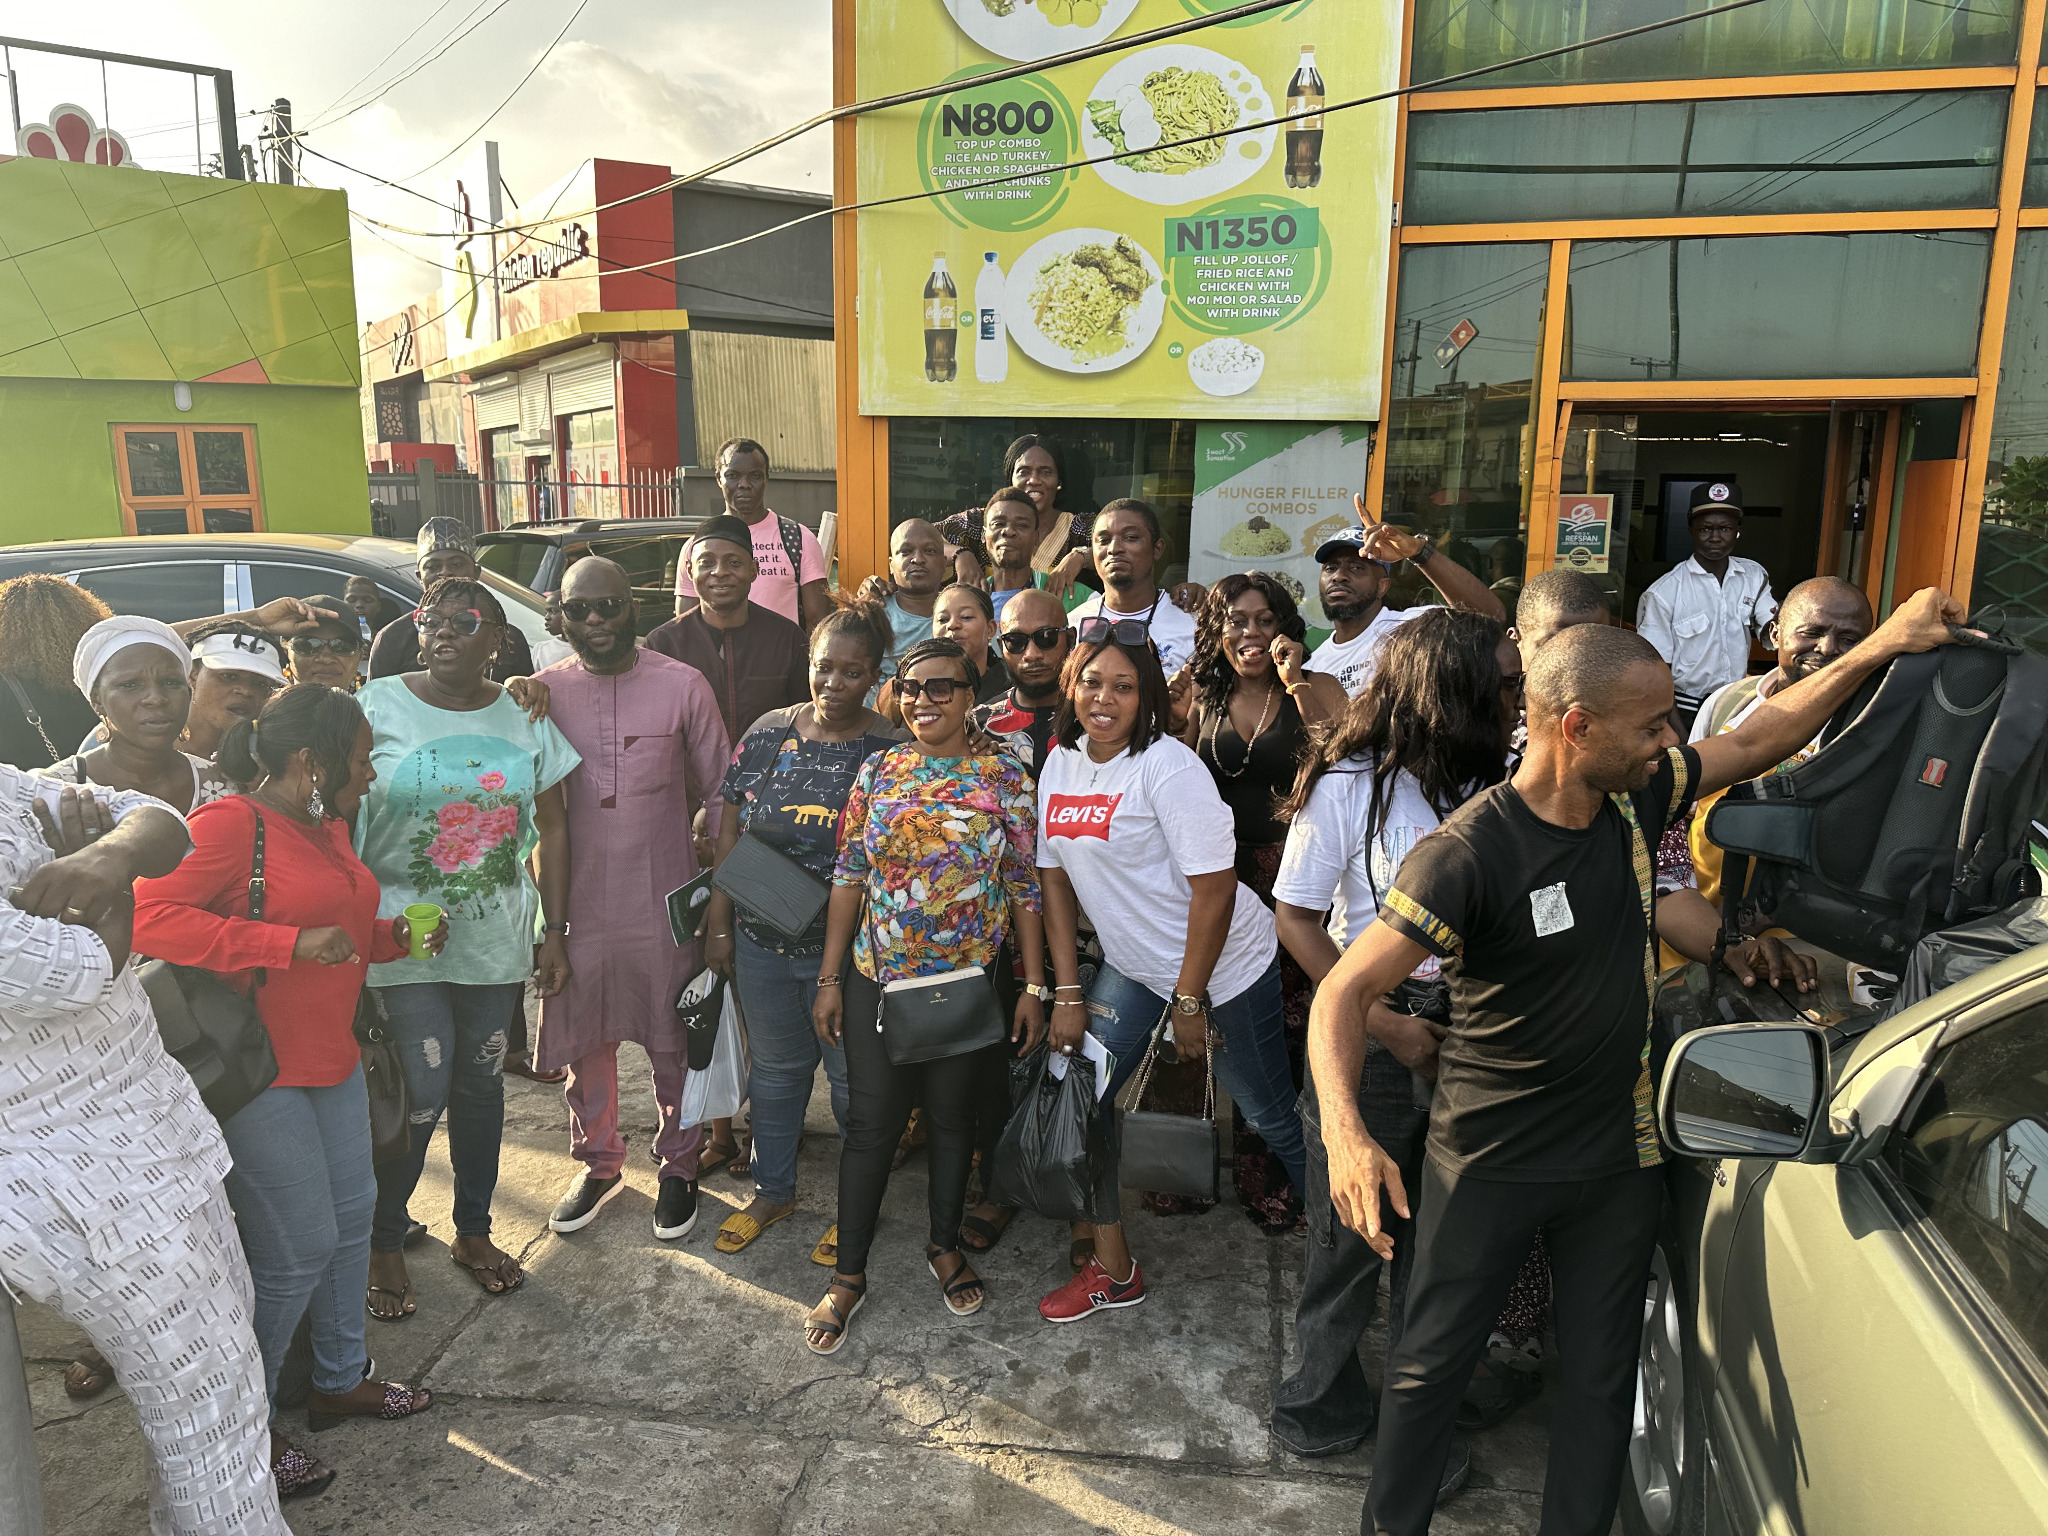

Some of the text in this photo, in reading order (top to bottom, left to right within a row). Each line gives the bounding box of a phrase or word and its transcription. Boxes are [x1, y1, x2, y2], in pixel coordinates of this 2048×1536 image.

[943, 101, 1054, 137] N800
[955, 138, 1041, 149] TOP UP COMBO
[944, 150, 1052, 163] RICE AND TURKEY/
[931, 166, 981, 176] CHICKEN
[983, 165, 1000, 175] OR
[944, 179, 969, 189] AND
[1004, 176, 1051, 187] CHUNKS
[963, 190, 1032, 201] WITH DRINK
[1177, 214, 1297, 252] N1350
[1193, 256, 1219, 266] FILL
[1222, 255, 1239, 265] UP
[1241, 254, 1289, 265] JOLLOF
[1196, 268, 1294, 279] FRIED RICE AND
[1199, 281, 1290, 292] CHICKEN WITH
[1187, 294, 1302, 305] MOI MOI OR SALAD
[1207, 308, 1281, 318] WITH DRINK
[1169, 346, 1183, 354] OR
[1218, 487, 1348, 499] HUNGER FILLER
[1246, 502, 1317, 515] COMBOS
